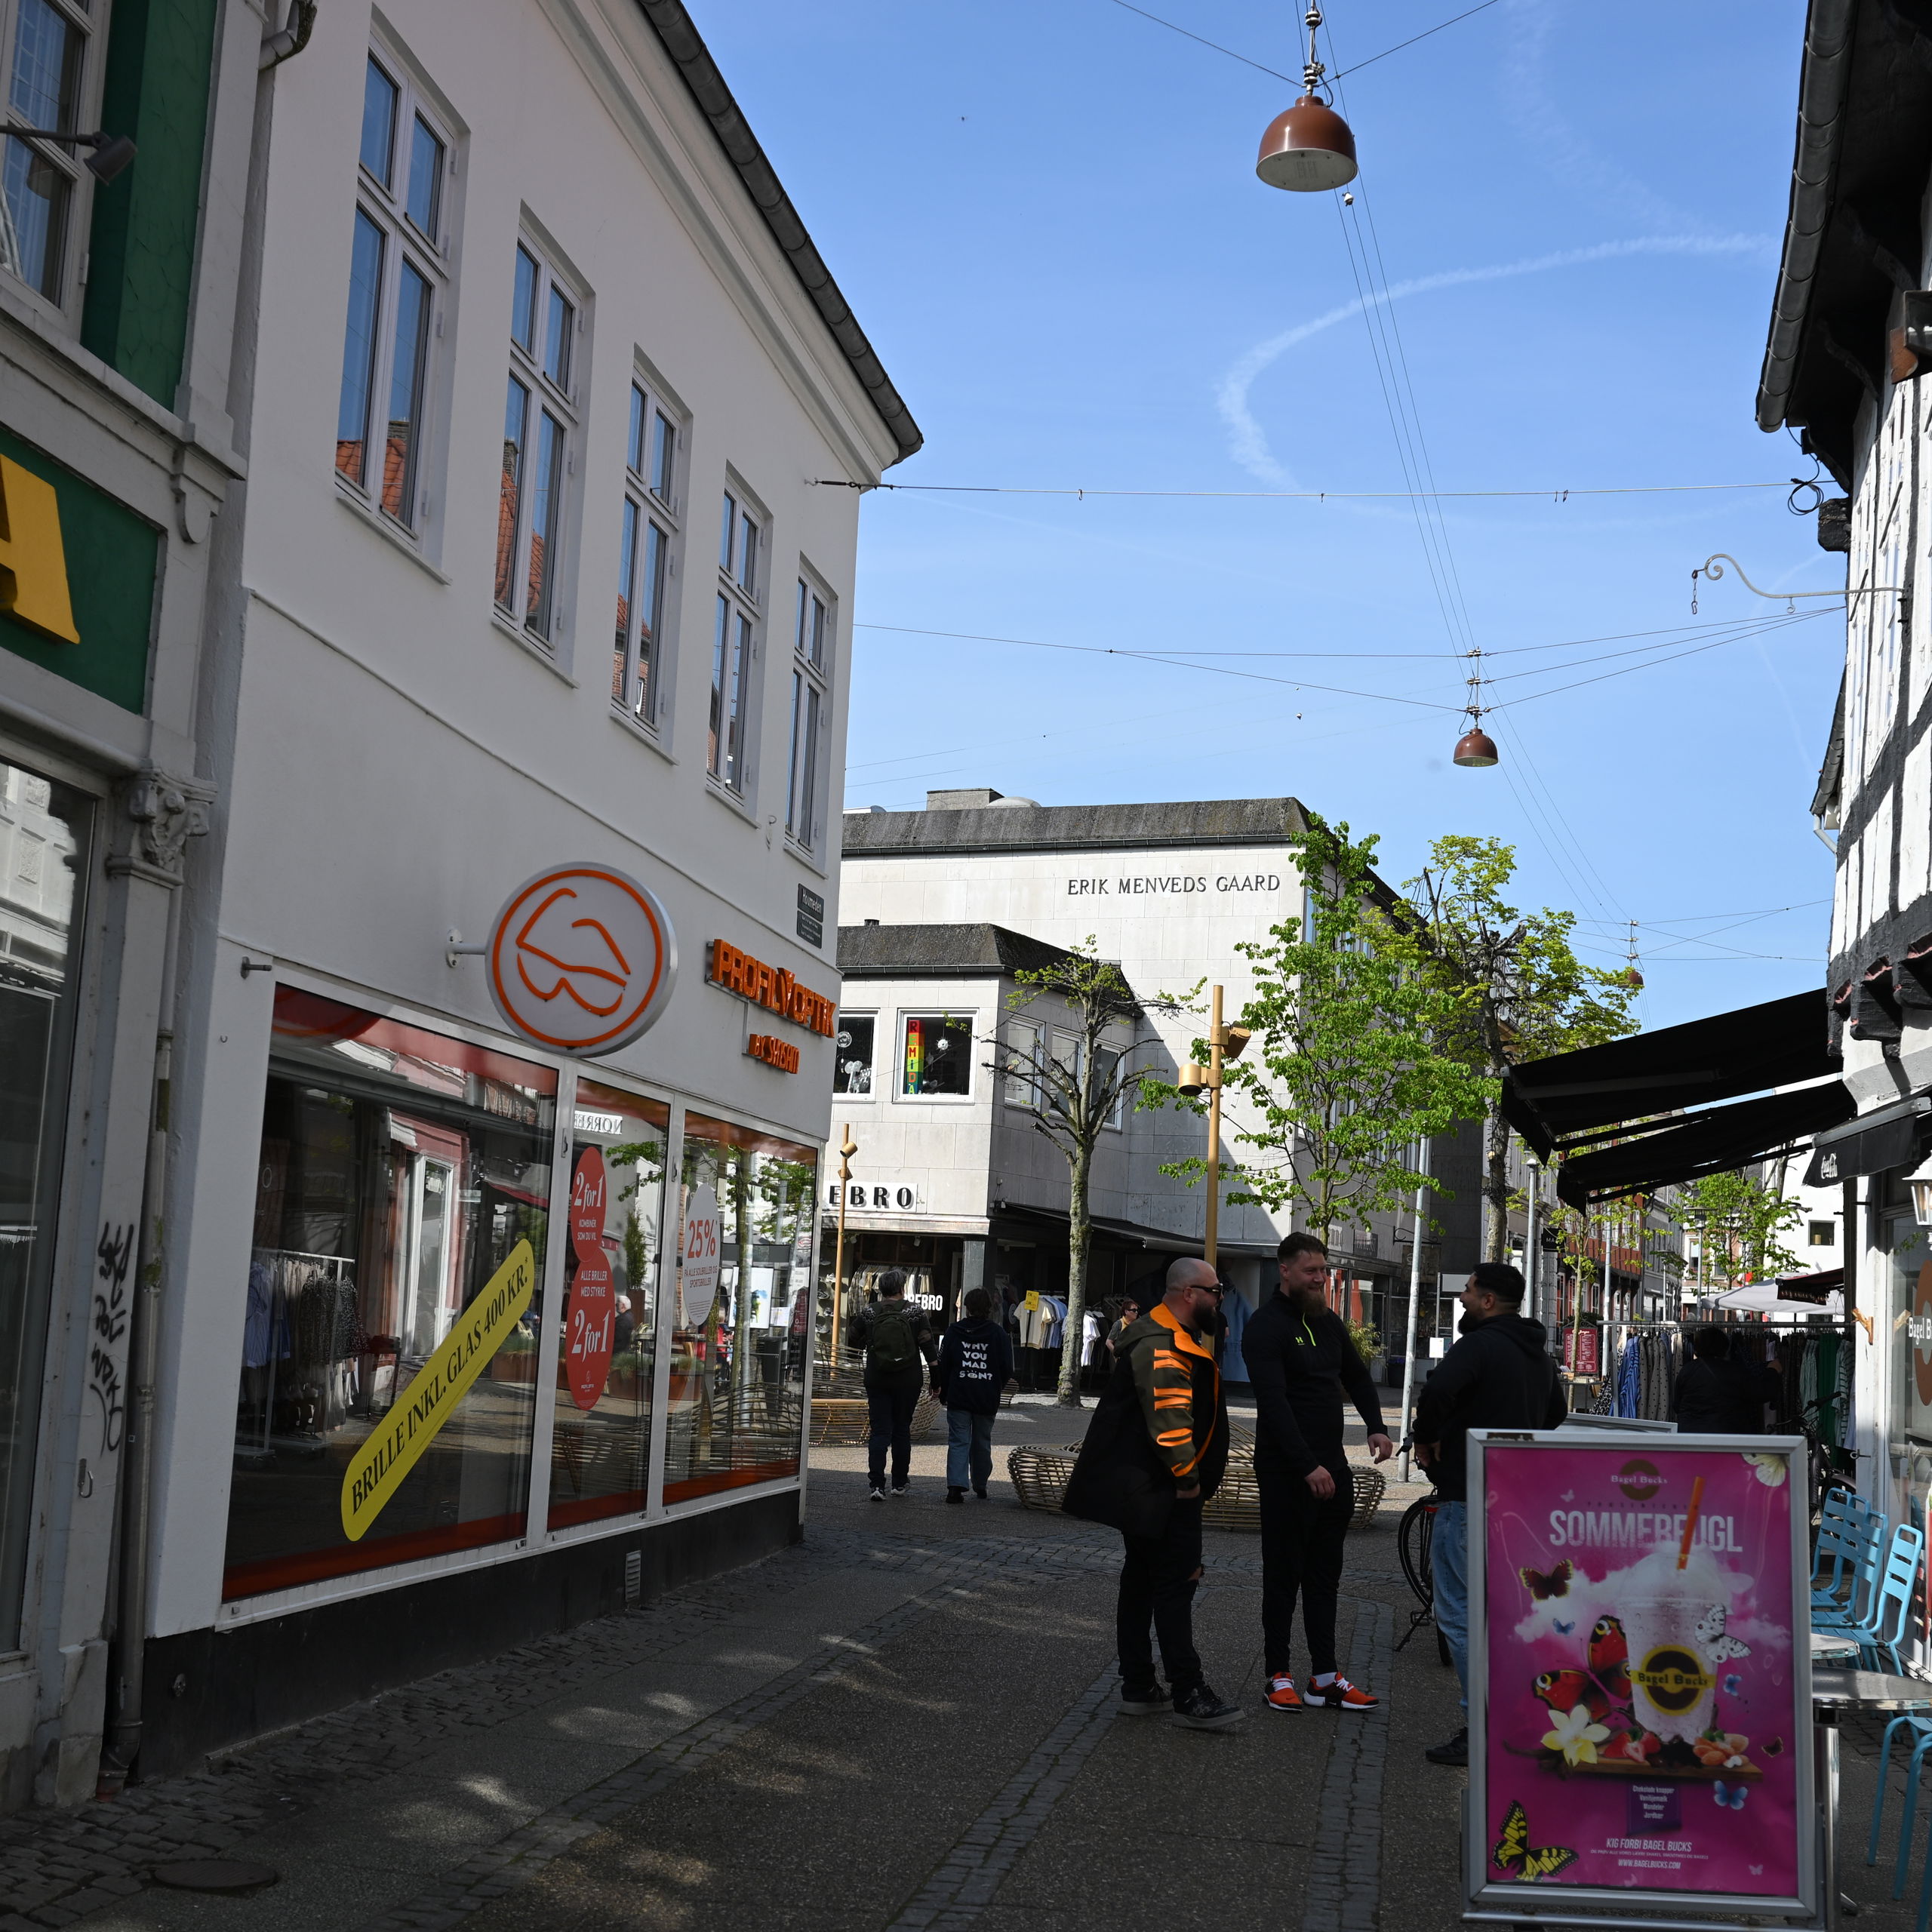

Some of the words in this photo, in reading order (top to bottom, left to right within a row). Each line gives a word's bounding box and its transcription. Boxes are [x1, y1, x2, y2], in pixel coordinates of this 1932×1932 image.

[1068, 878, 1109, 895] ERIK
[1118, 877, 1207, 894] MENVEDS
[1216, 875, 1281, 892] GAARD
[580, 1270, 591, 1281] ALLE
[592, 1270, 608, 1281] BRILLER
[580, 1287, 590, 1297] MED
[590, 1287, 606, 1297] STYRKE
[1909, 1317, 1924, 1345] Bagel
[961, 1341, 989, 1351] WHY
[963, 1351, 987, 1361] YOU
[962, 1360, 987, 1369] MAD
[352, 1421, 405, 1515] BRILLE
[408, 1374, 447, 1441] INKL.
[447, 1320, 481, 1383] GLAS
[484, 1289, 506, 1334] 400
[1611, 1475, 1636, 1485] Bagel
[1640, 1475, 1668, 1484] Bucks
[1638, 1672, 1669, 1686] Bagel
[1674, 1675, 1708, 1685] Bucks
[1606, 1838, 1619, 1848] KIG
[1620, 1838, 1641, 1850] FORBI
[1642, 1839, 1666, 1850] BAGEL
[1667, 1841, 1692, 1852] BUCKS
